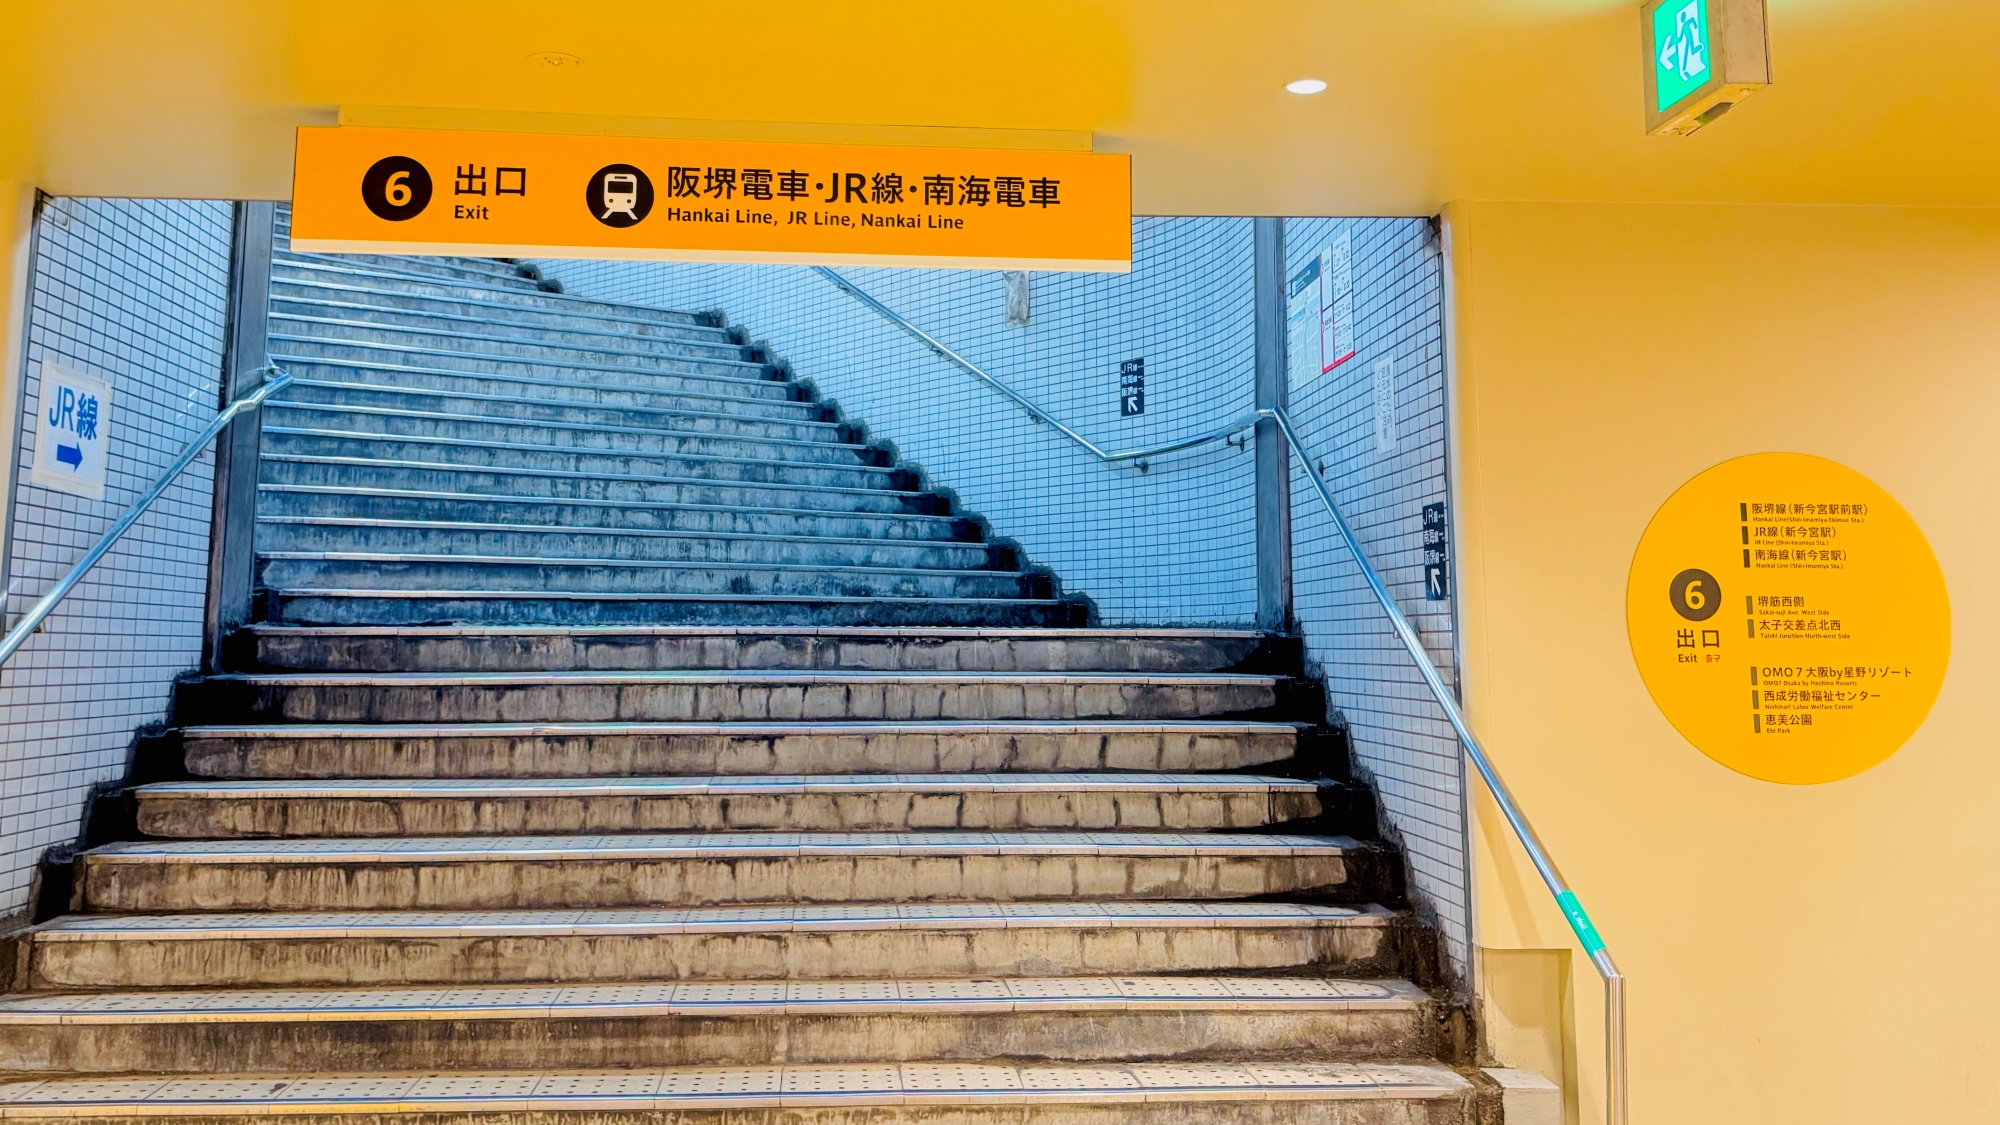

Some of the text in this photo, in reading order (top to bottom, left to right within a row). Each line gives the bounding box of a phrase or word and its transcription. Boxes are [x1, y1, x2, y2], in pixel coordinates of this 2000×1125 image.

[384, 170, 413, 207] 6
[454, 163, 527, 197] 出口
[455, 205, 489, 220] Exit
[667, 207, 964, 230] Hankai Line, JR Line, Nankai Line
[50, 385, 99, 441] JR線
[1684, 580, 1706, 610] 6
[1758, 595, 1805, 607] 堺筋西側
[1759, 619, 1841, 631] 太子交差点北西
[1677, 628, 1720, 649] 出口
[1678, 653, 1698, 663] Exit
[1763, 690, 1881, 702] 西成労働福祉センター
[1765, 714, 1813, 726] 恵美公園
